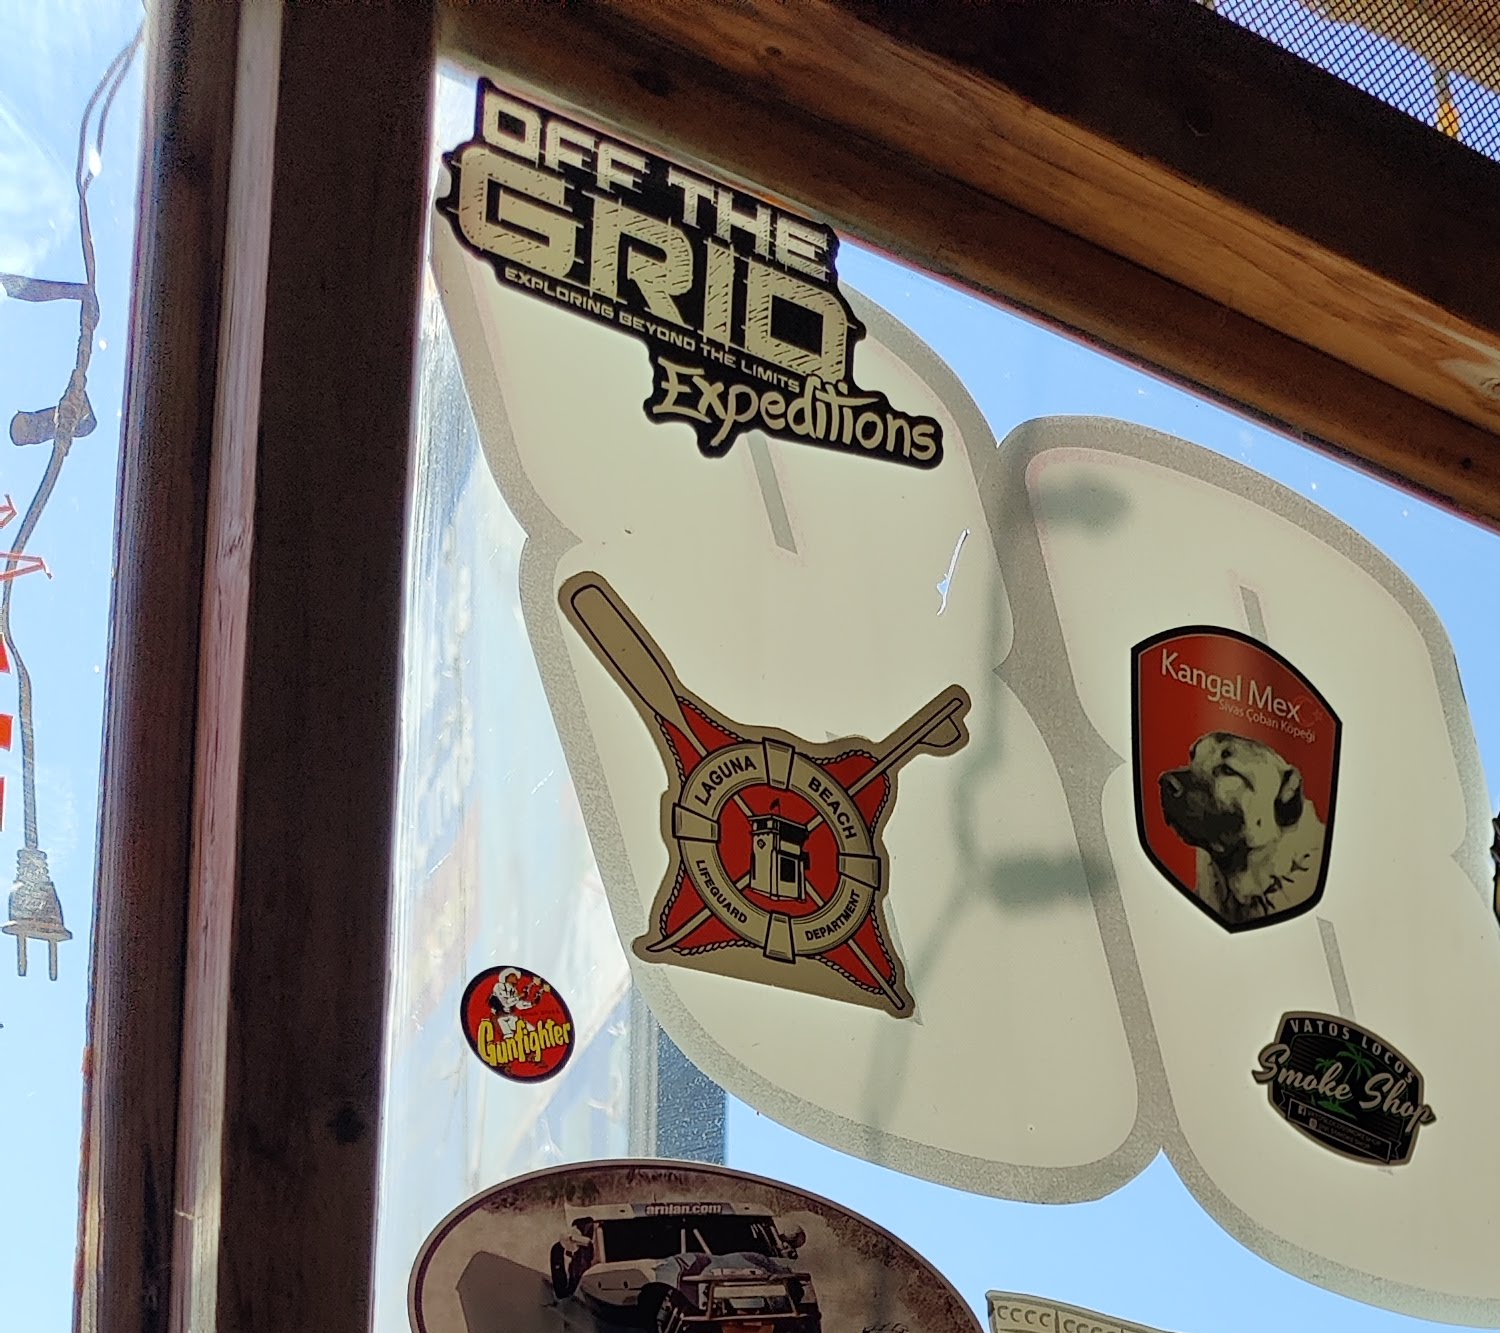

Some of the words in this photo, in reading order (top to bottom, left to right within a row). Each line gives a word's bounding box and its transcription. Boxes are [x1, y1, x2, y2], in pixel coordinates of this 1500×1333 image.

[482, 86, 649, 191] OFF
[667, 166, 831, 281] THE
[458, 147, 850, 384] GRID
[504, 266, 615, 320] EXPLORING
[619, 313, 696, 352] BEYOND
[700, 343, 738, 368] THE
[740, 360, 800, 392] LIMITS
[653, 356, 937, 460] Expeditions
[1161, 649, 1243, 703] Kangal
[1248, 680, 1302, 723] Mex
[1218, 699, 1245, 718] Sivas
[695, 754, 758, 807] LAGUNA
[807, 775, 858, 840] BEACH
[695, 858, 749, 925] LIFEGUARD
[804, 889, 862, 942] DEPARTMENT
[477, 1018, 571, 1067] Gunfighter
[1290, 1019, 1350, 1041] VATOS
[1361, 1035, 1415, 1084] LOCOS
[1251, 1042, 1354, 1101] Smoke
[1358, 1072, 1437, 1134] Shop
